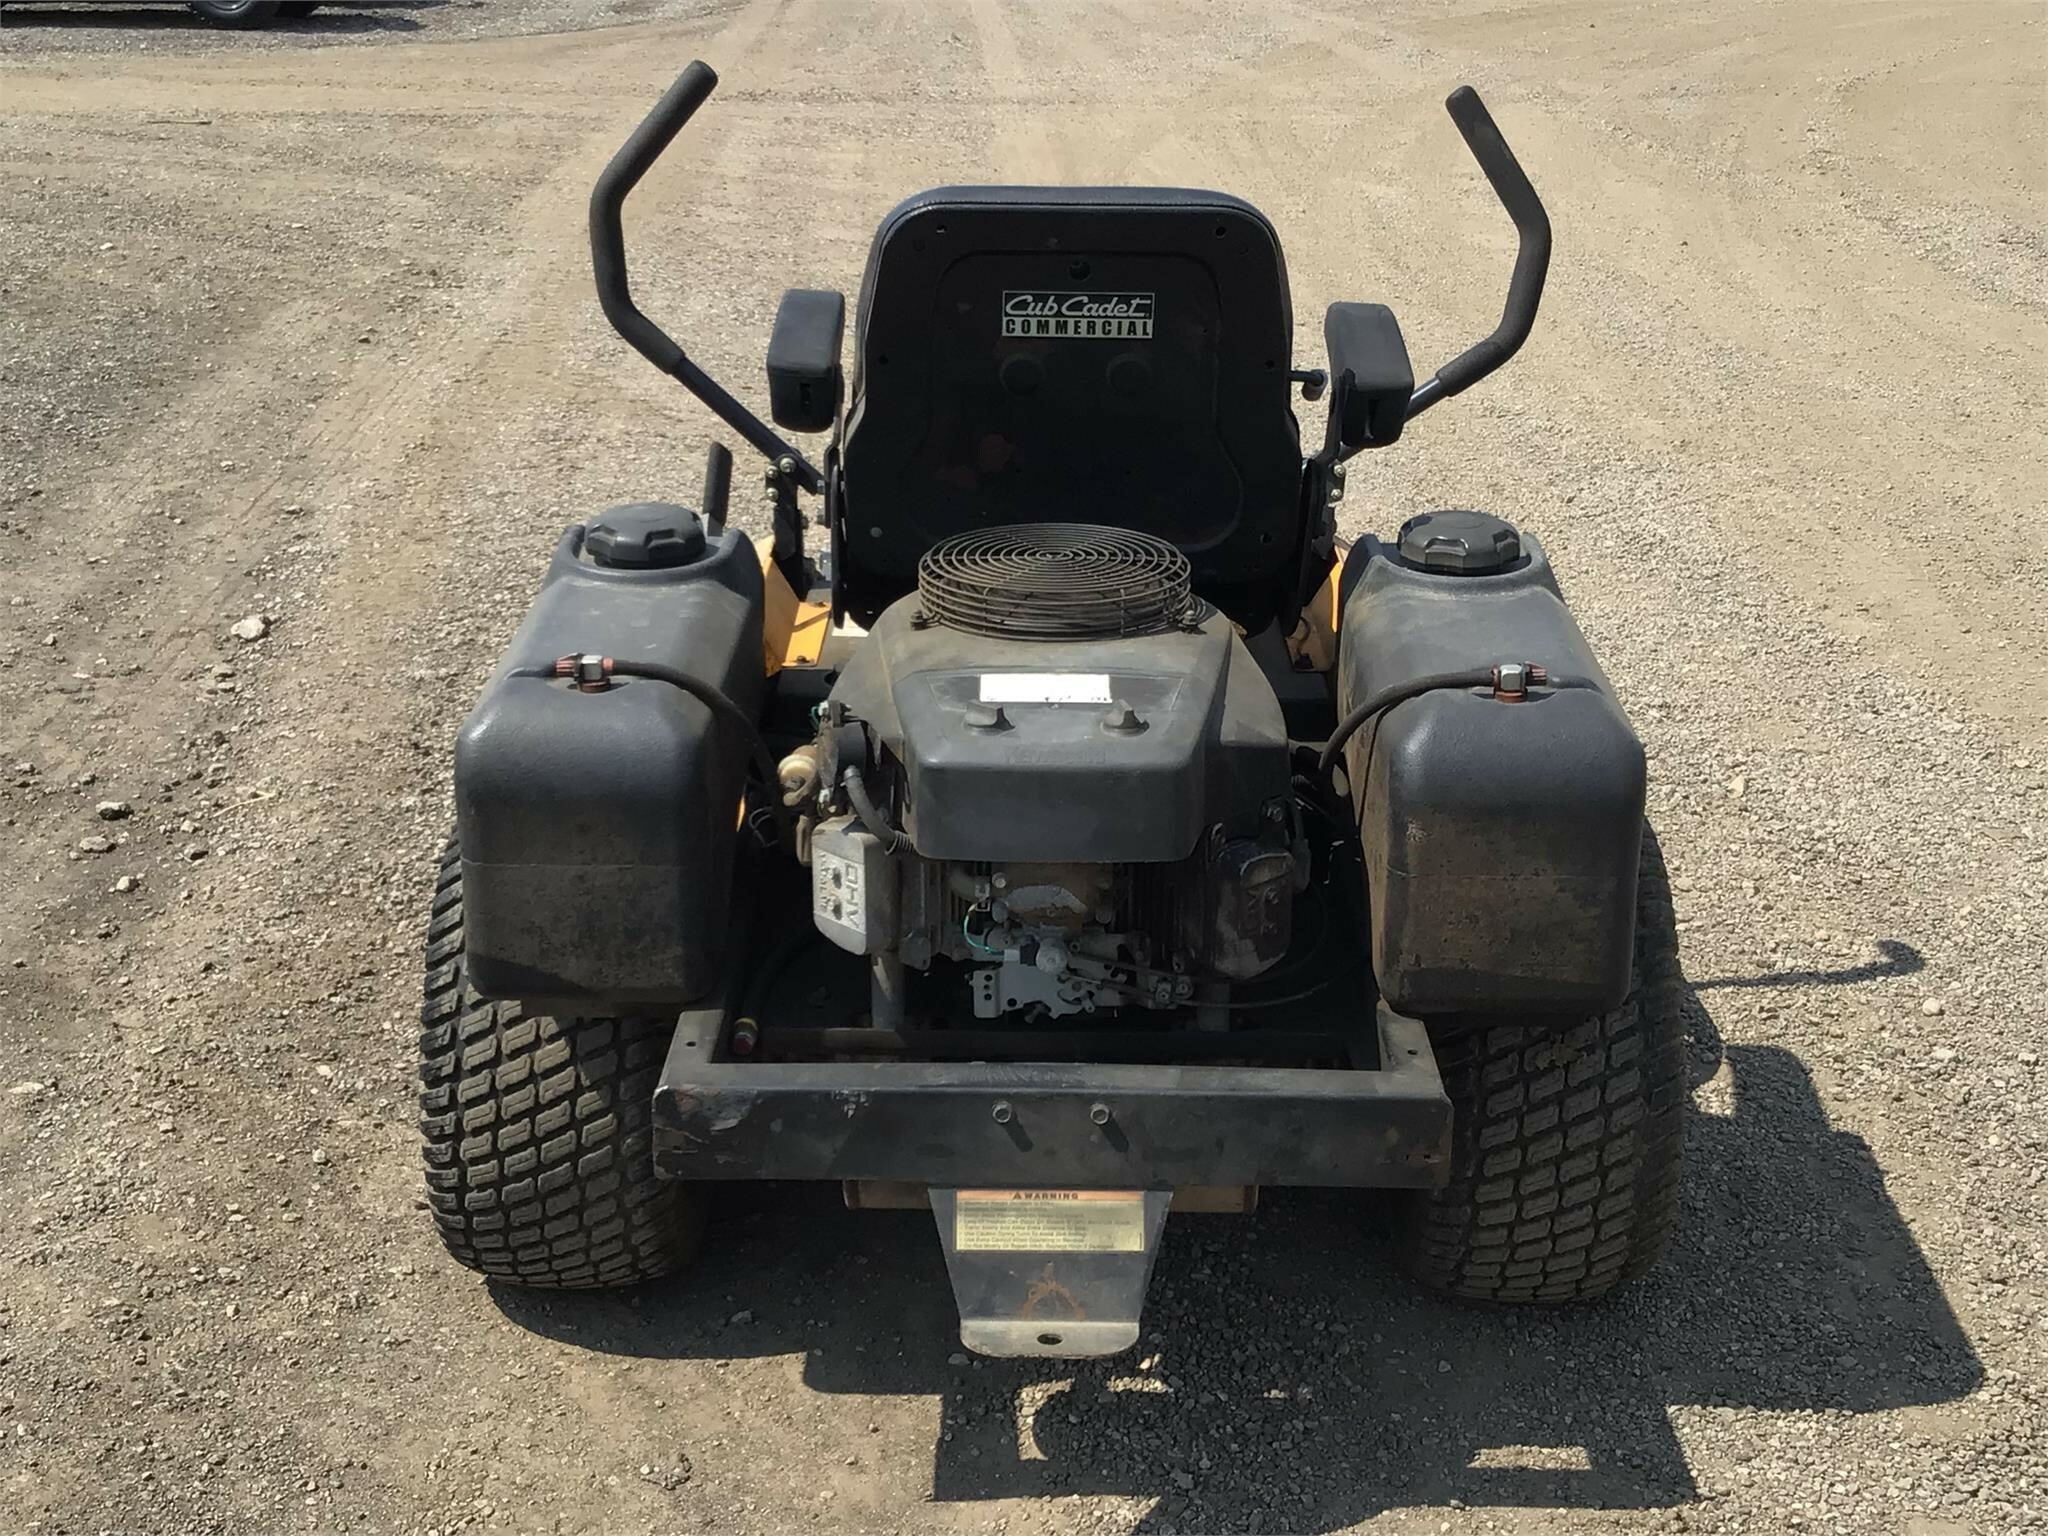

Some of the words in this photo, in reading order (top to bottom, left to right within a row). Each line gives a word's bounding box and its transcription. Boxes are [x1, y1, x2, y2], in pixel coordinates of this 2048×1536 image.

[1005, 294, 1058, 316] Cub
[1061, 295, 1151, 317] Cadet
[1005, 318, 1150, 336] COMMERCIAL
[1024, 1191, 1079, 1200] WARNING
